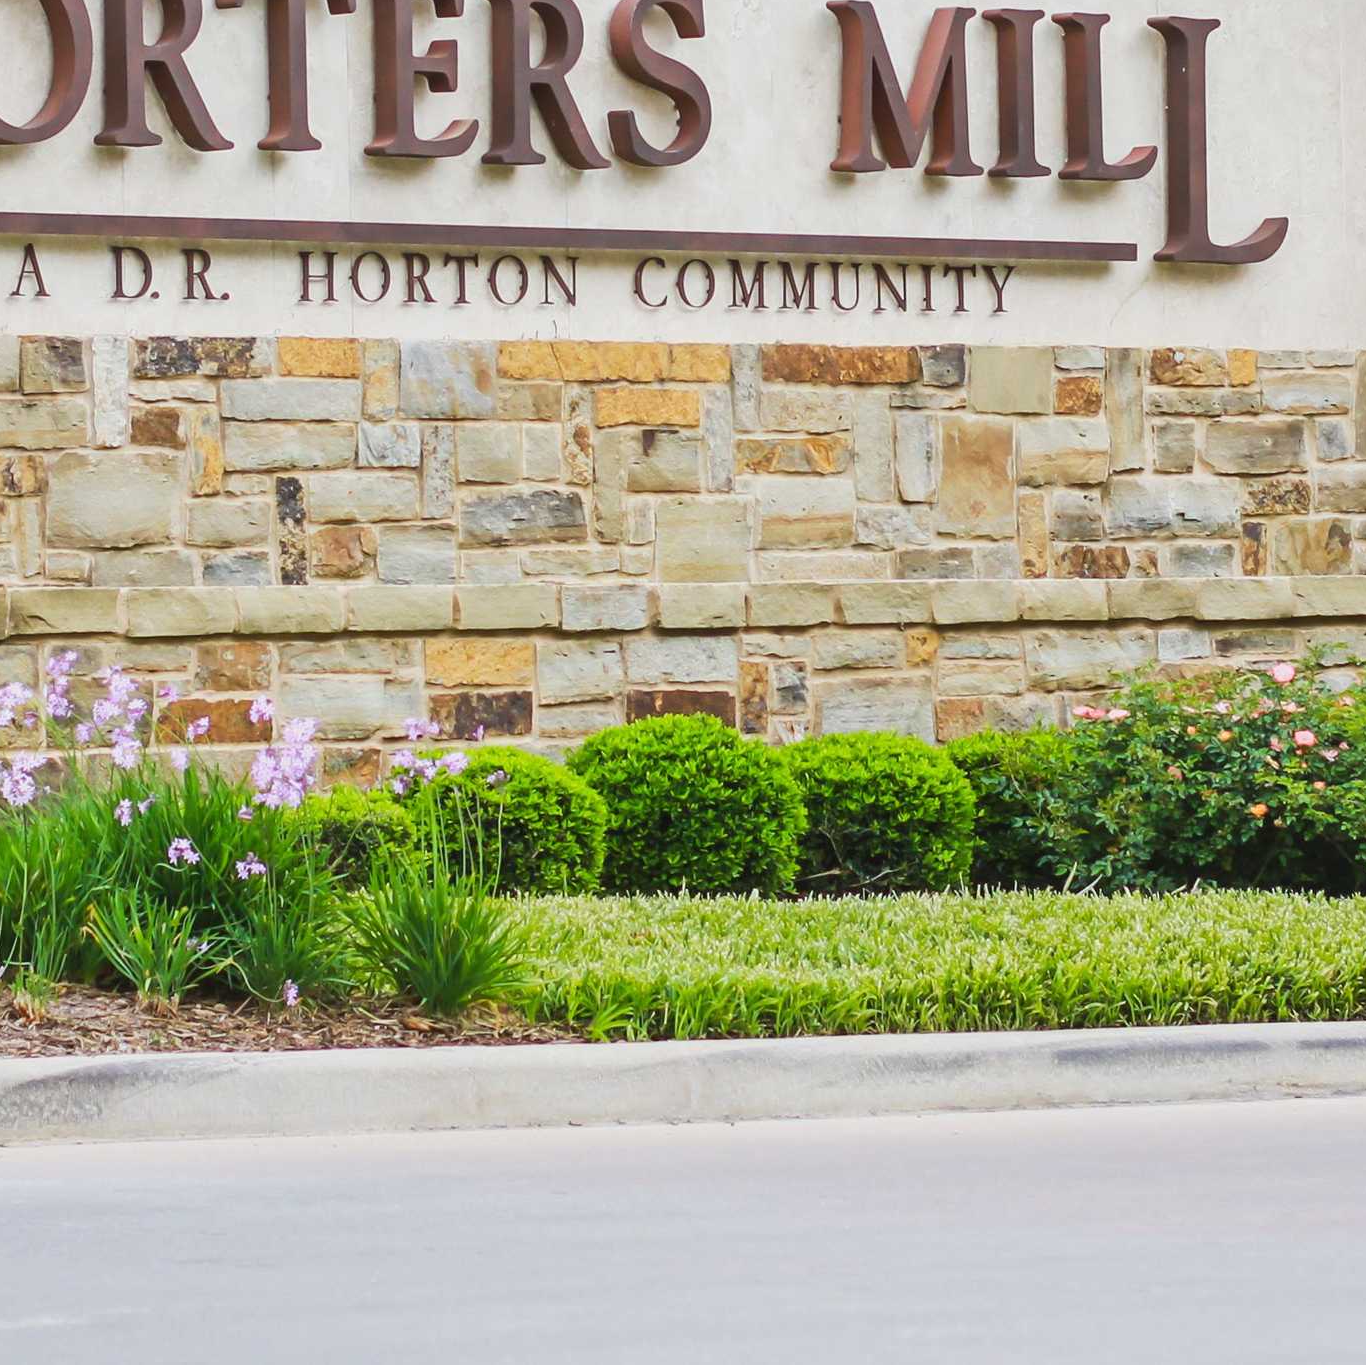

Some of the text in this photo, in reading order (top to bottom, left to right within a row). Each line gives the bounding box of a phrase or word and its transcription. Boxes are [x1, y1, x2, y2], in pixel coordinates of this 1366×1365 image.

[825, 0, 1290, 264] MILL
[9, 242, 51, 299] A
[297, 250, 580, 307] HORTON
[633, 256, 1017, 314] COMMUNITY
